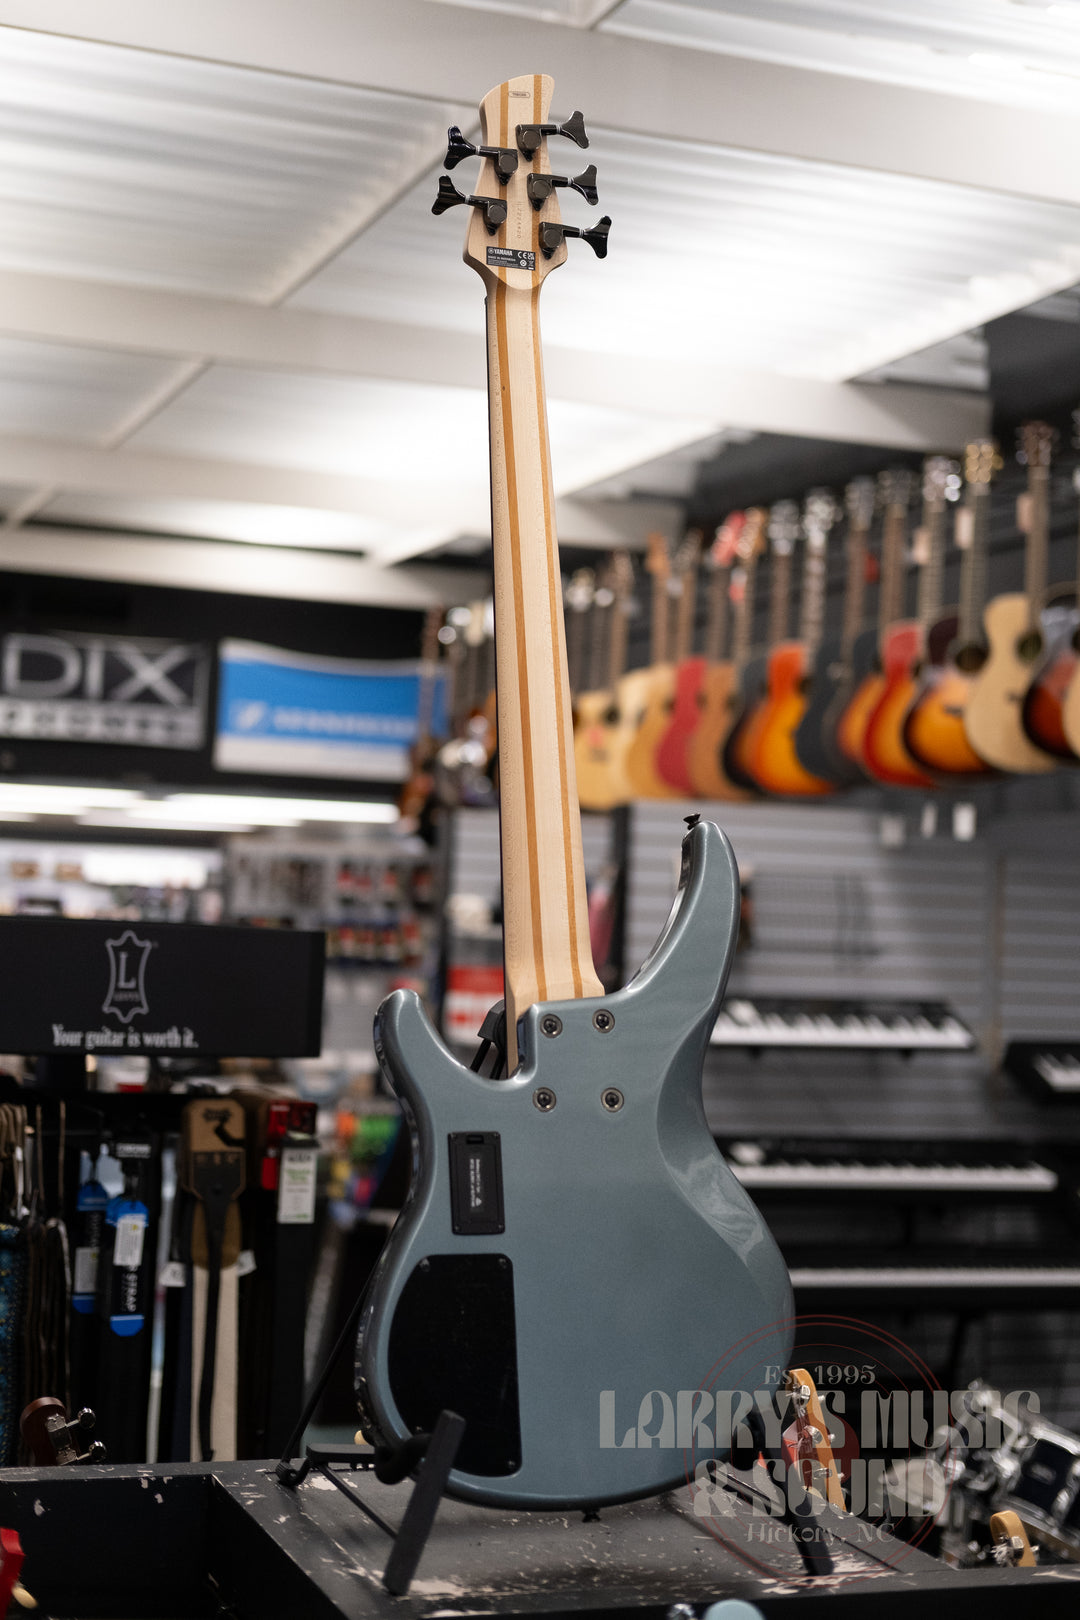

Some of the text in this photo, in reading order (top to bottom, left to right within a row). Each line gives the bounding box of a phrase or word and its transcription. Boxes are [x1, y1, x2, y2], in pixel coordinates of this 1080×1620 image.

[52, 1024, 83, 1046] Your
[85, 1026, 125, 1050] guitar
[127, 1026, 141, 1047] is
[143, 1025, 181, 1048] worth
